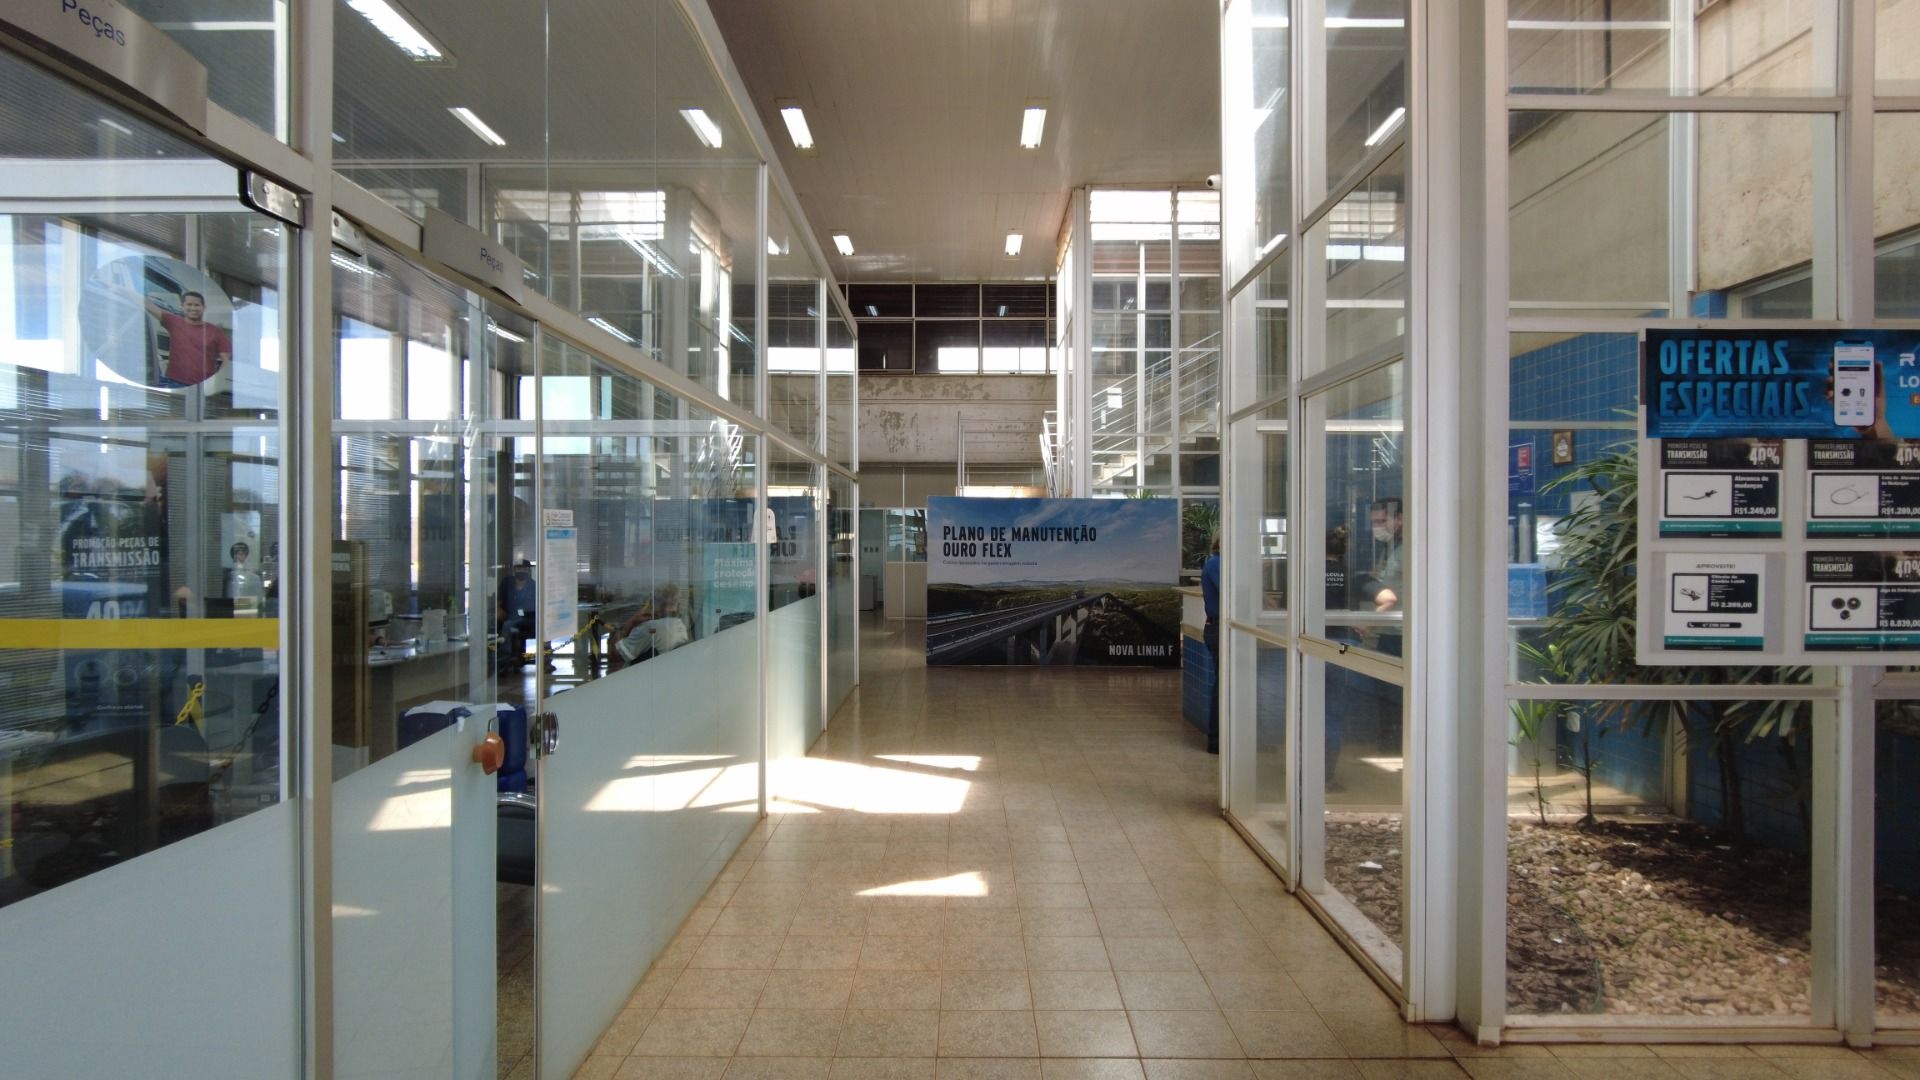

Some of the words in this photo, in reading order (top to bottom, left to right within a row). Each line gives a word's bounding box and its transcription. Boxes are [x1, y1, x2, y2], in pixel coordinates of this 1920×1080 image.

[62, 0, 126, 46] Peças
[1659, 339, 1790, 375] OFERTAS
[1658, 380, 1810, 418] ESPECIAIS
[1667, 449, 1708, 459] TRANSMISSÃO
[1749, 447, 1780, 466] 40%
[1814, 449, 1855, 460] TRANSMISSÃO
[72, 536, 117, 549] PROMOÇÃO
[119, 537, 146, 549] PEÇAS
[148, 536, 160, 547] DE
[943, 526, 985, 541] PLANO
[990, 527, 1007, 542] DE
[1011, 525, 1097, 544] MANUTENÇÃO
[72, 548, 160, 568] TRANSMISSÃO
[943, 542, 977, 557] OURO
[982, 543, 1012, 558] FLEX
[1812, 562, 1853, 572] TRANSMISSÃO
[1109, 645, 1134, 656] NOVA
[1137, 645, 1165, 656] LINHA
